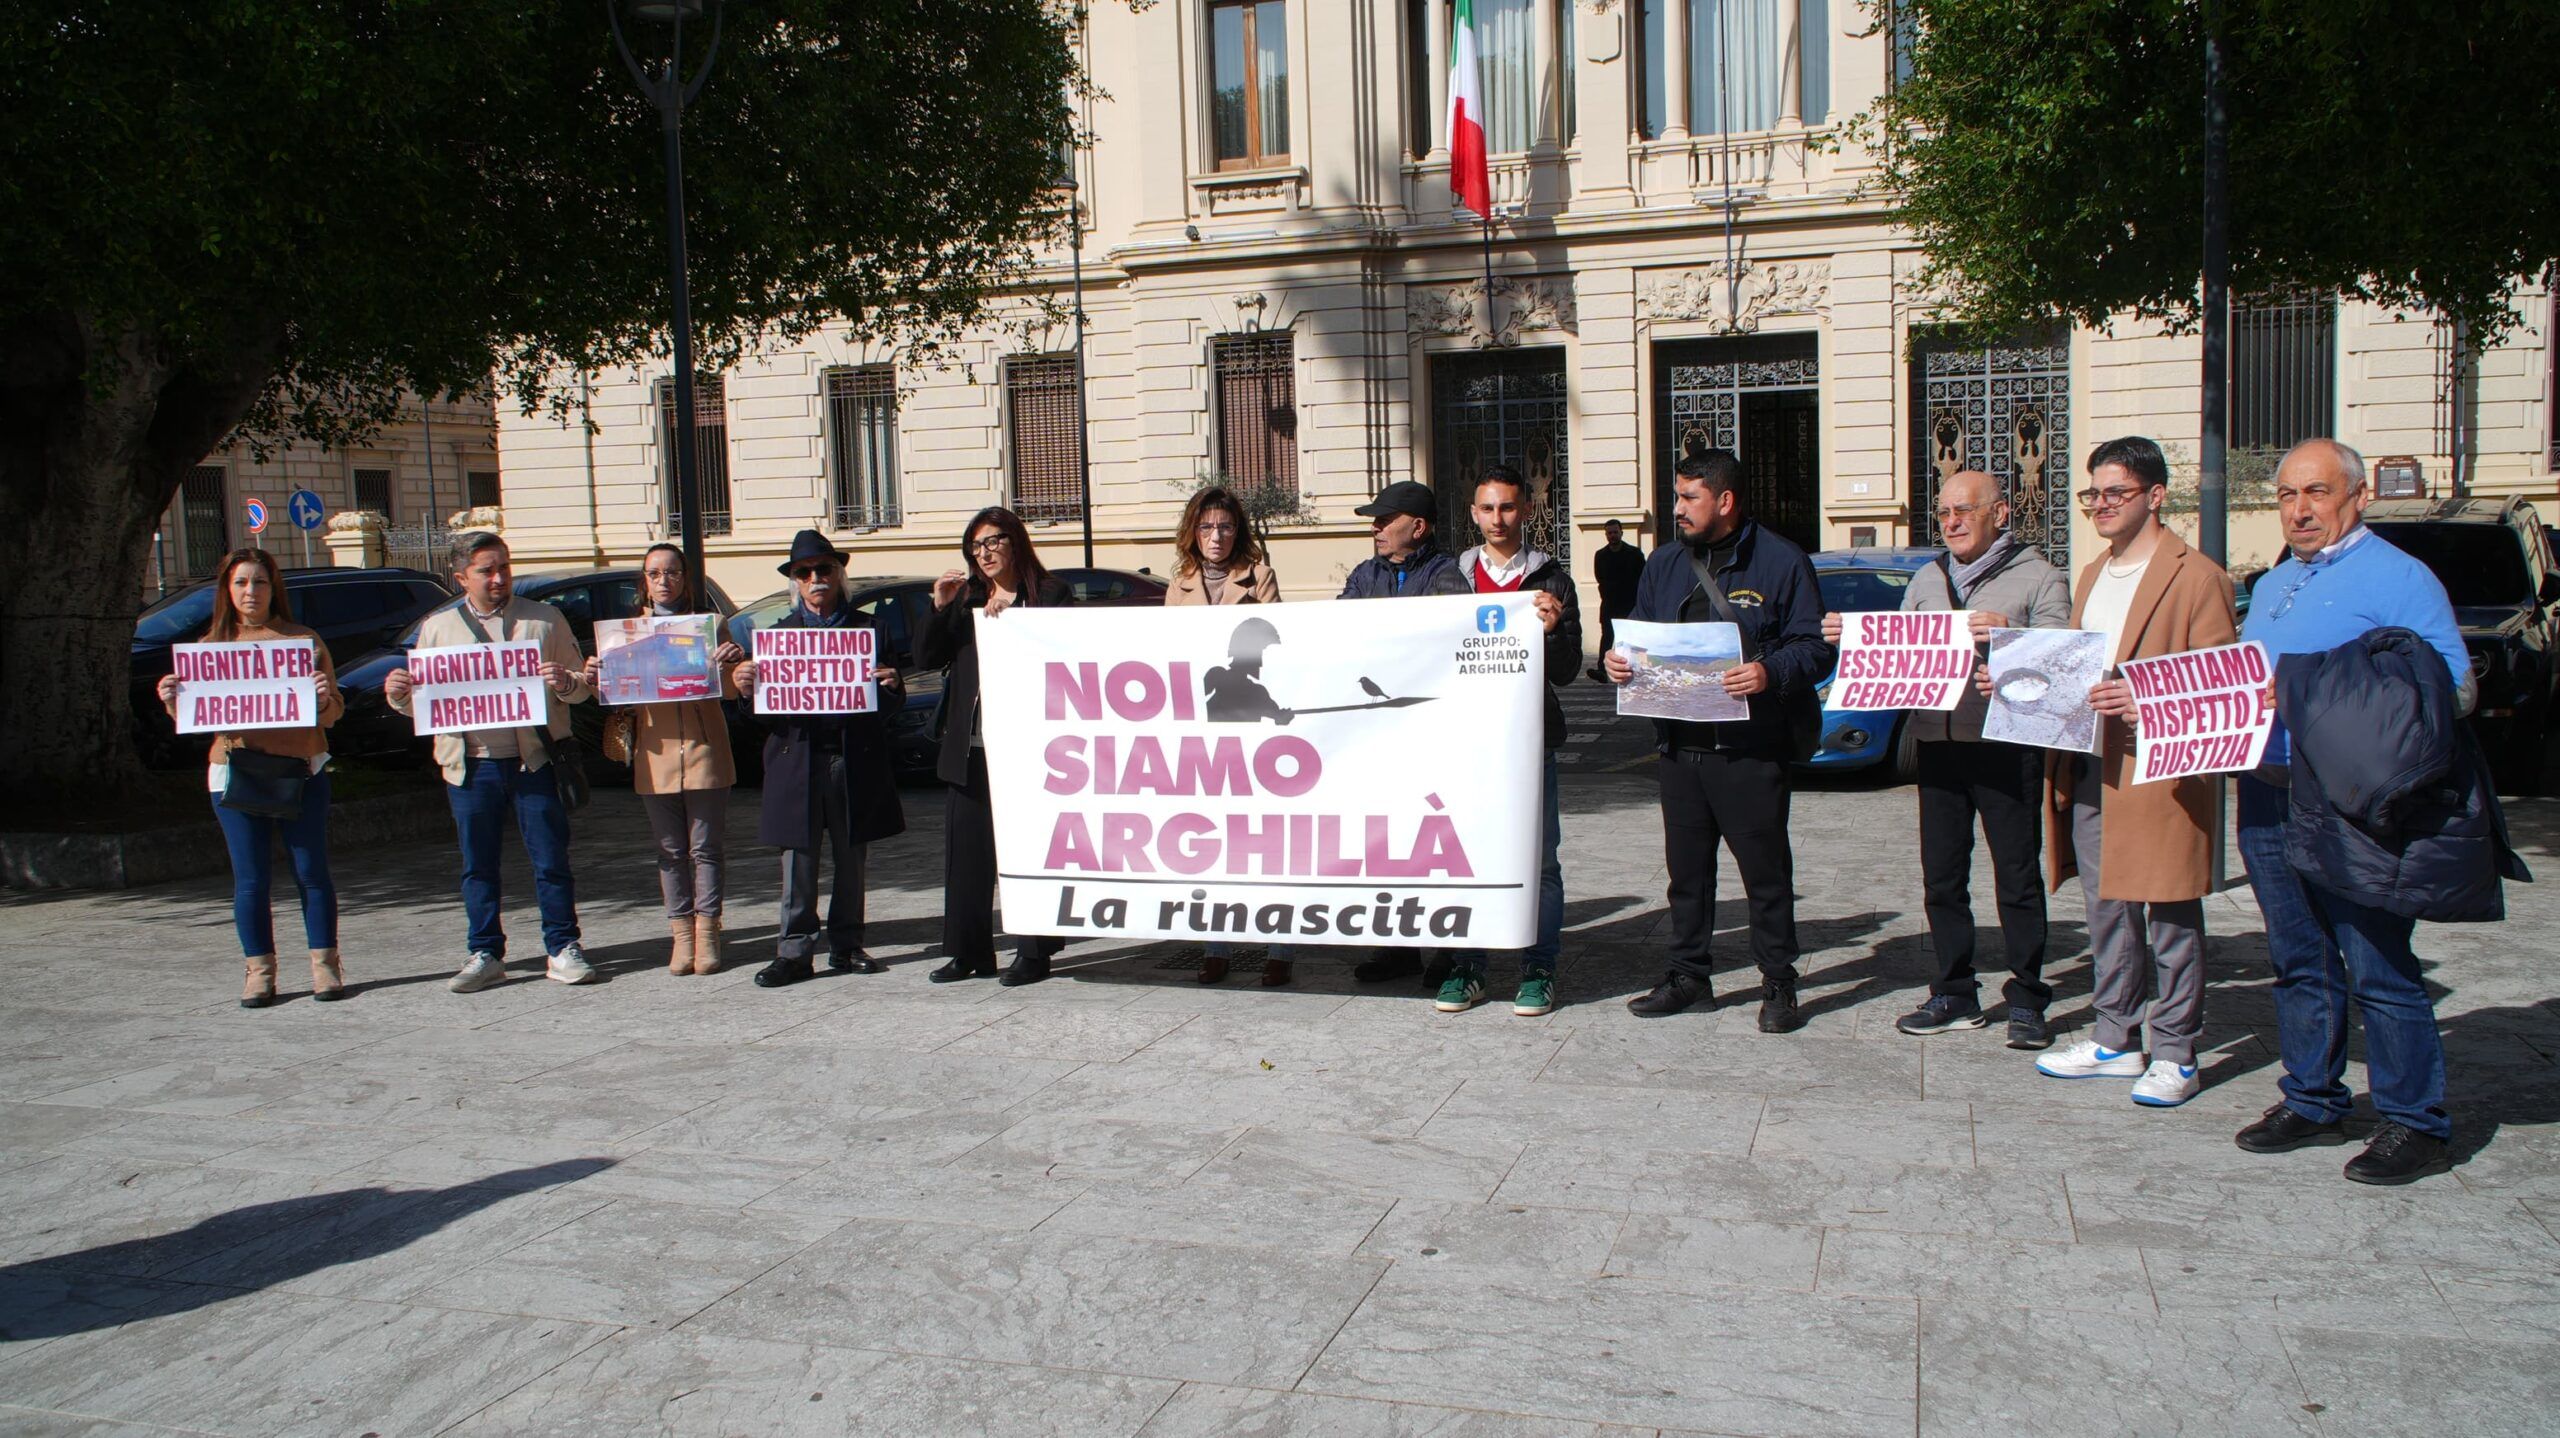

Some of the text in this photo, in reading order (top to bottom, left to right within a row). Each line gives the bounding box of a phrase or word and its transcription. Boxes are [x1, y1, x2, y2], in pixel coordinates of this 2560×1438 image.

[756, 630, 872, 656] MERITIAMO
[1462, 636, 1521, 648] GRUPPO:
[1861, 614, 1952, 646] SERVIZI
[176, 643, 313, 682] DIGNITÀ PER
[410, 646, 540, 685] DIGNITÀ PER
[759, 658, 872, 684] RISPETTO E
[1455, 649, 1529, 661] NOI SIAMO
[1459, 660, 1527, 675] ARGHILLÀ
[1838, 649, 1971, 679] ESSENZIALI
[2124, 645, 2267, 700] MERITIAMO
[193, 687, 300, 726] ARGHILLÀ
[430, 687, 531, 728] ARGHILLÀ
[766, 686, 867, 711] GIUSTIZIA
[1044, 660, 1196, 722] NOI
[1841, 681, 1949, 708] CERCASI
[2140, 688, 2267, 740] RISPETTO E
[1043, 734, 1322, 798] SIAMO
[2145, 732, 2254, 780] GIUSTIZIA
[1043, 792, 1475, 878] ARGHILLÀ
[1056, 885, 1473, 938] La rinascita
